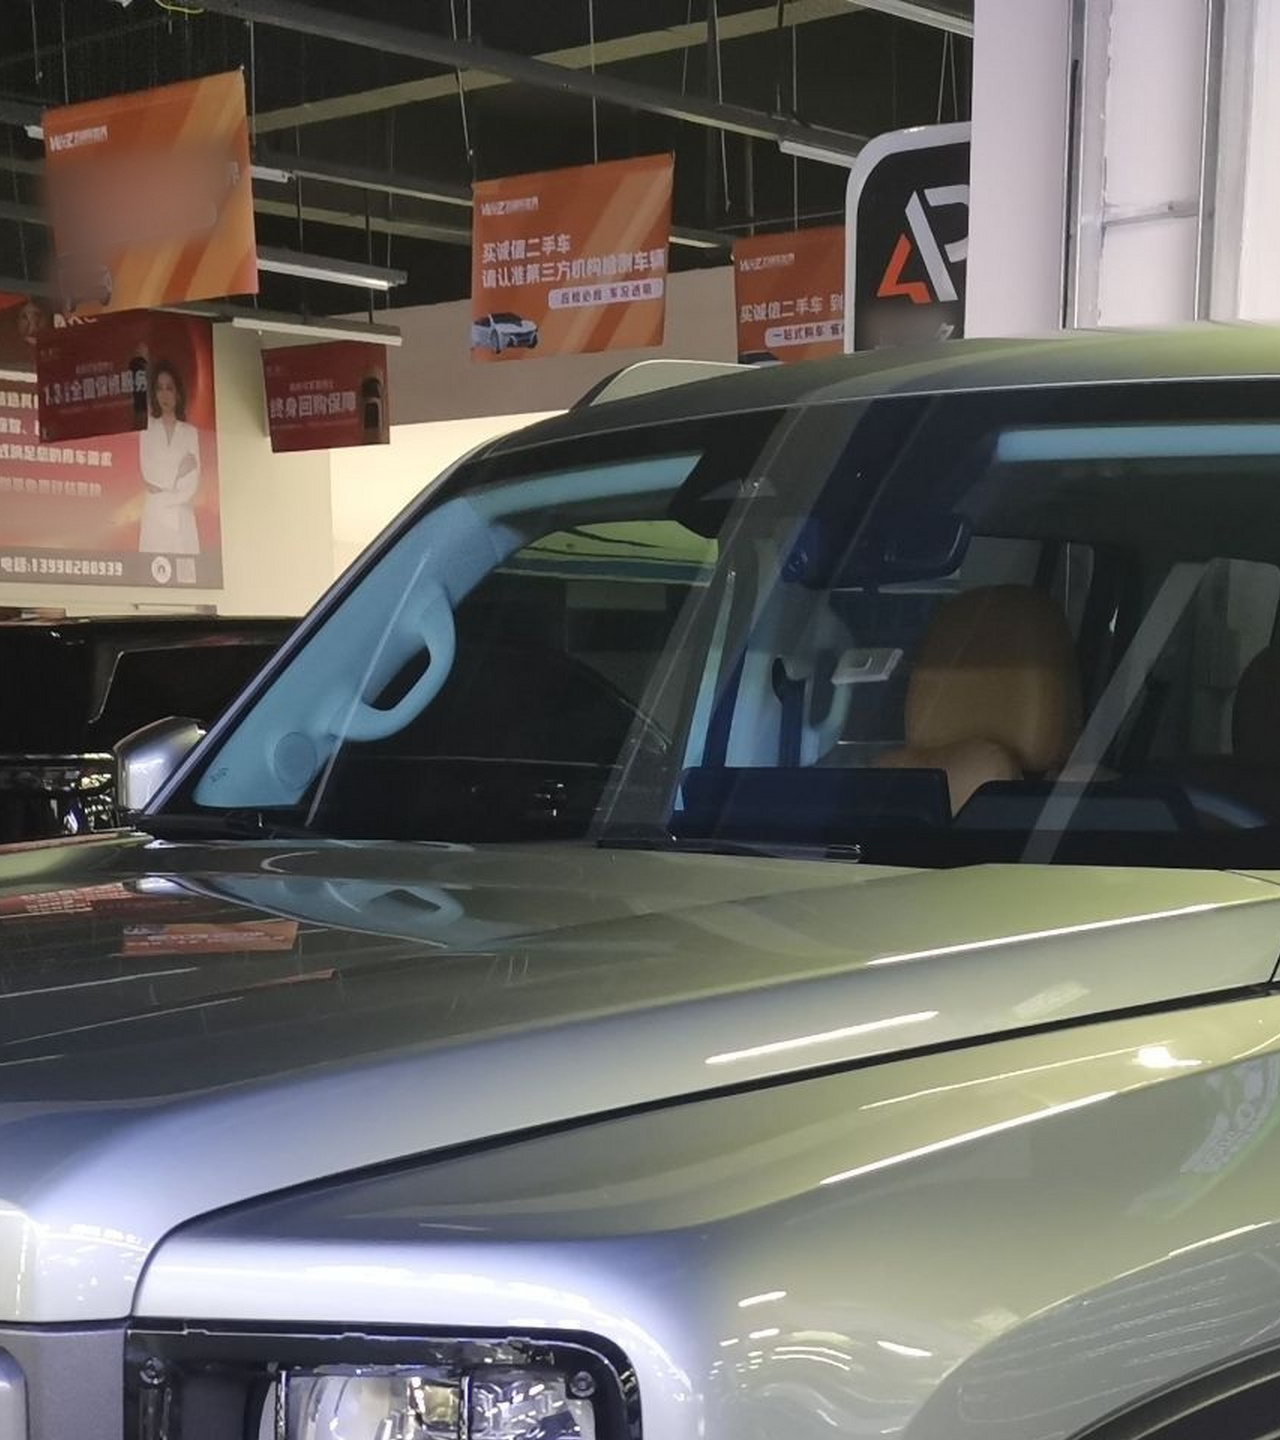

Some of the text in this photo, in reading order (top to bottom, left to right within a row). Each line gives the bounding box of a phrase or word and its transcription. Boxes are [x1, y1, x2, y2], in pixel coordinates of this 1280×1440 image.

[482, 234, 571, 264] 买诚信二手车
